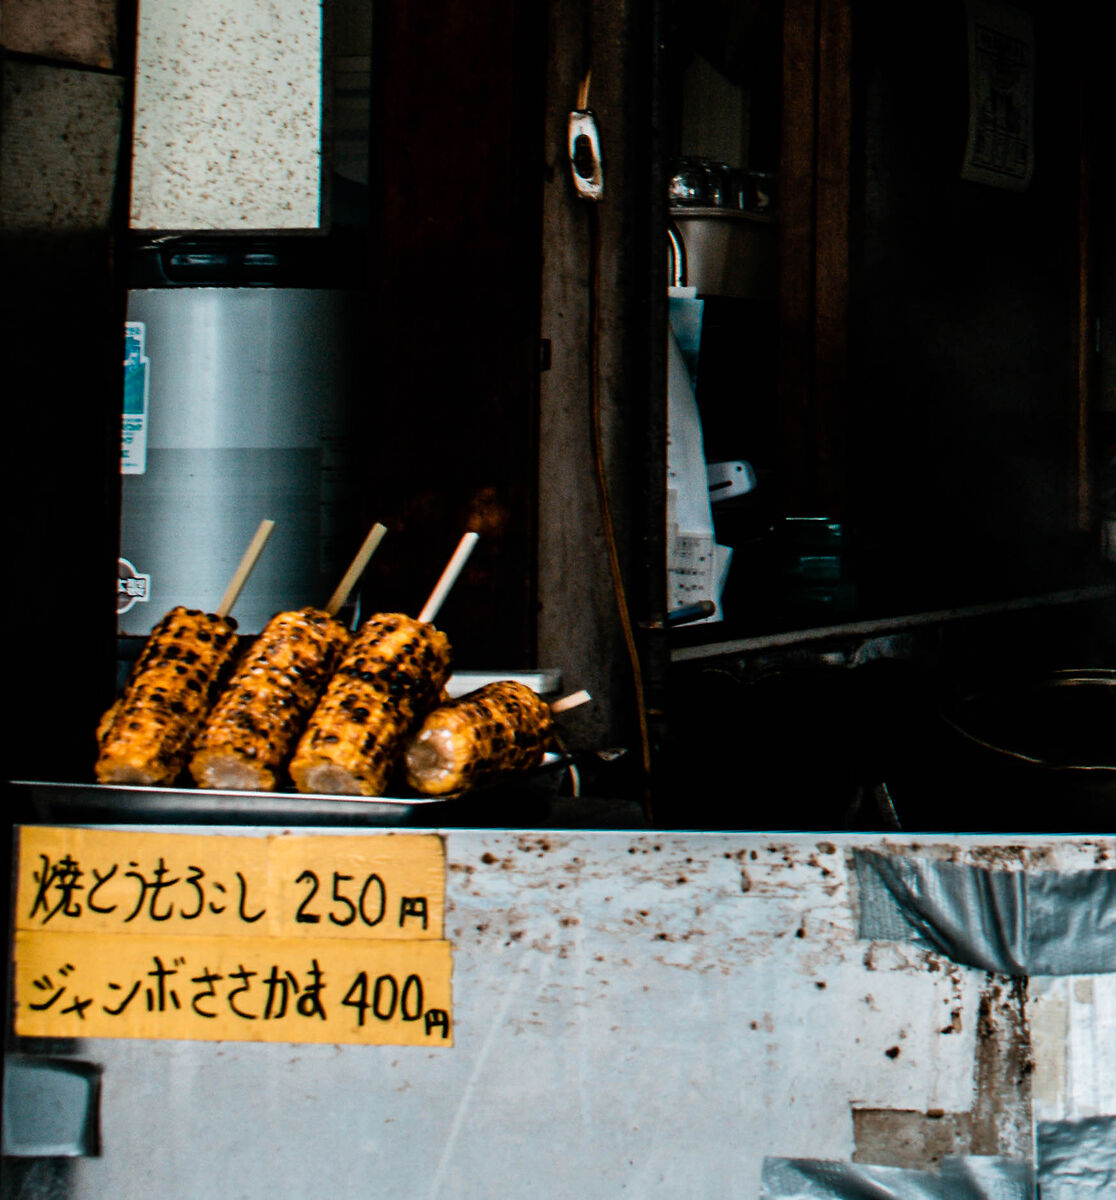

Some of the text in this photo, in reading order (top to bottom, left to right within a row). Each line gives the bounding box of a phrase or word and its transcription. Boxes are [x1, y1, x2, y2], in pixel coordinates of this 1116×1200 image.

[29, 853, 266, 926] 焼とうもろこし
[28, 955, 327, 1021] ジャンボささかま
